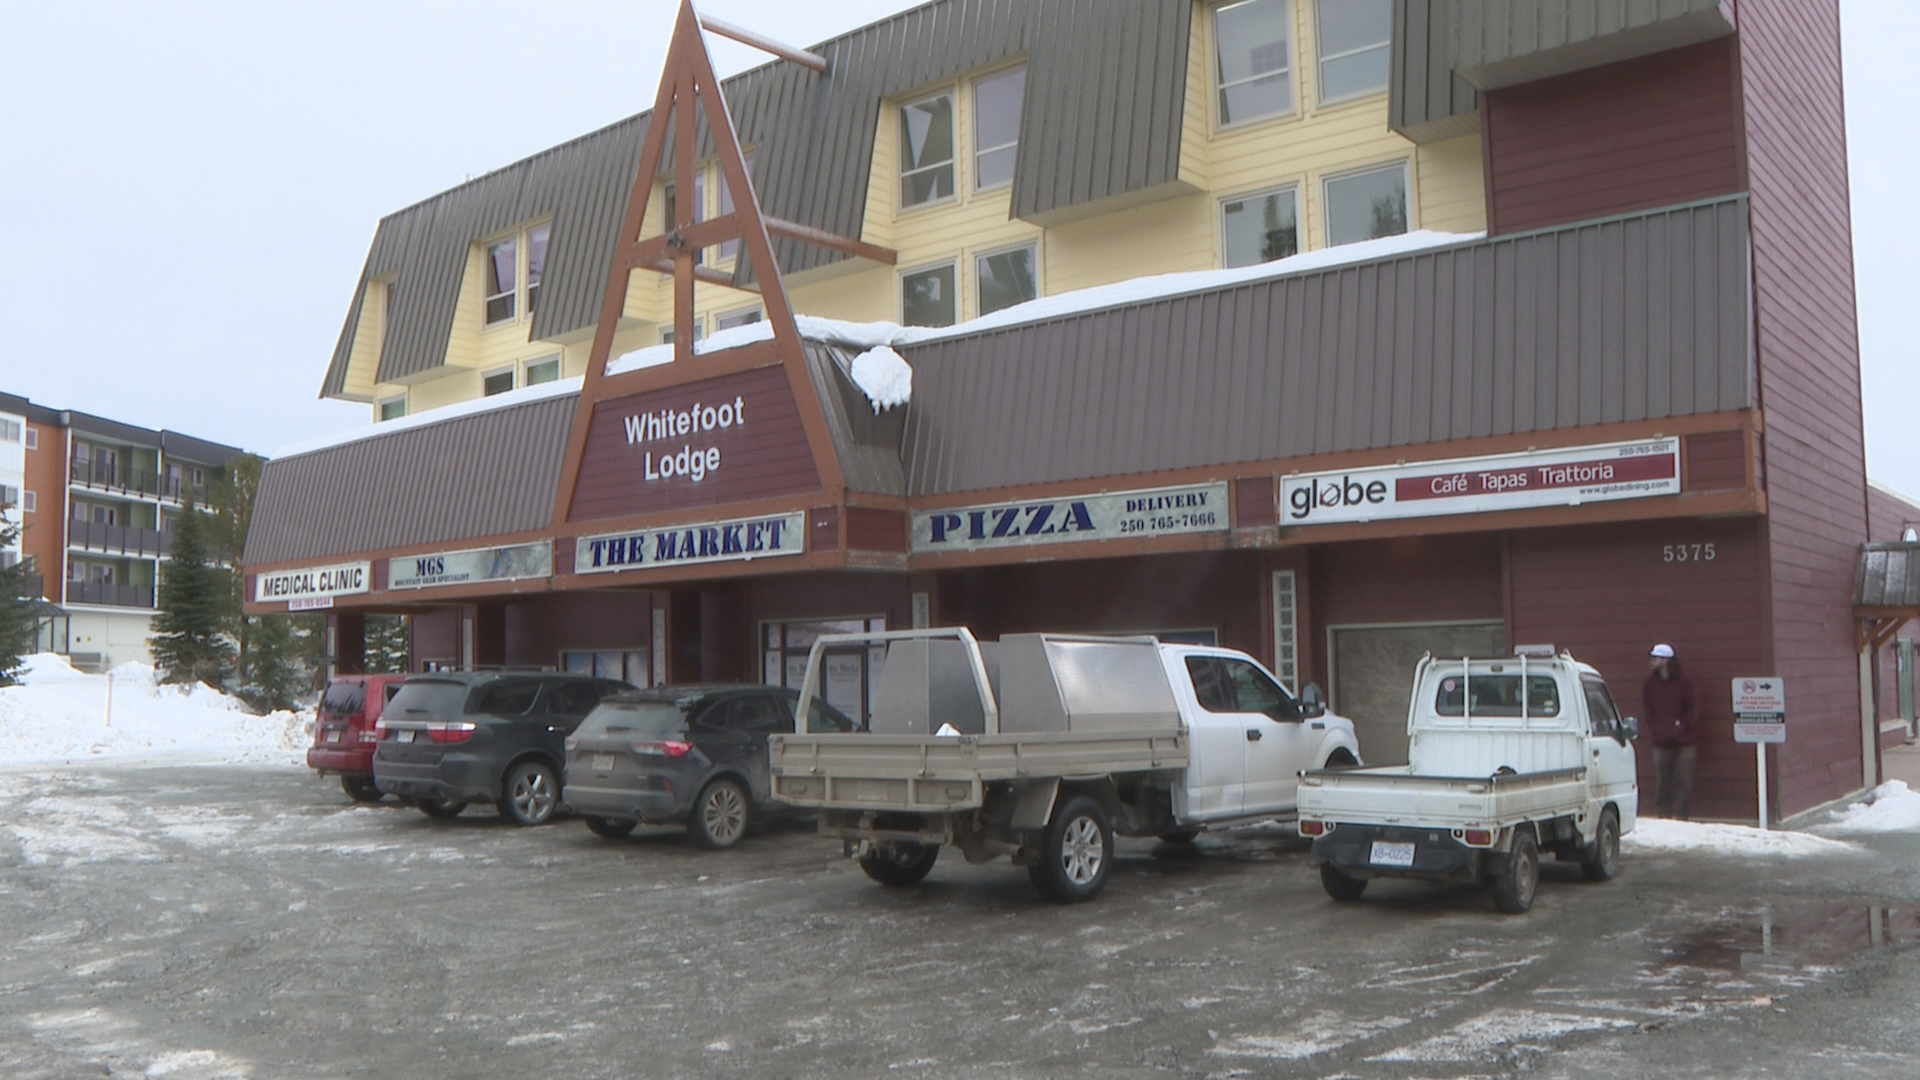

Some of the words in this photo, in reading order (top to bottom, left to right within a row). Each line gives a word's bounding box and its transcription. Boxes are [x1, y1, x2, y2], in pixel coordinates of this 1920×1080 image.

[624, 396, 744, 444] Whitefoot
[644, 444, 721, 482] Lodge
[1431, 474, 1468, 494] Café
[1479, 472, 1528, 491] Tapas
[1538, 463, 1614, 484] Trattoria
[1579, 480, 1670, 495] www.globedining.com
[1126, 492, 1208, 513] DELIVERY
[1291, 476, 1387, 519] globe
[929, 501, 1096, 543] PIZZA
[1120, 519, 1144, 532] 250
[1150, 512, 1215, 530] 765-7666
[590, 535, 644, 567] THE
[654, 518, 786, 561] MARKET
[1663, 543, 1716, 562] 5375
[415, 557, 444, 577] MGS
[263, 574, 316, 597] MEDICAL
[319, 568, 362, 592] CLINIC
